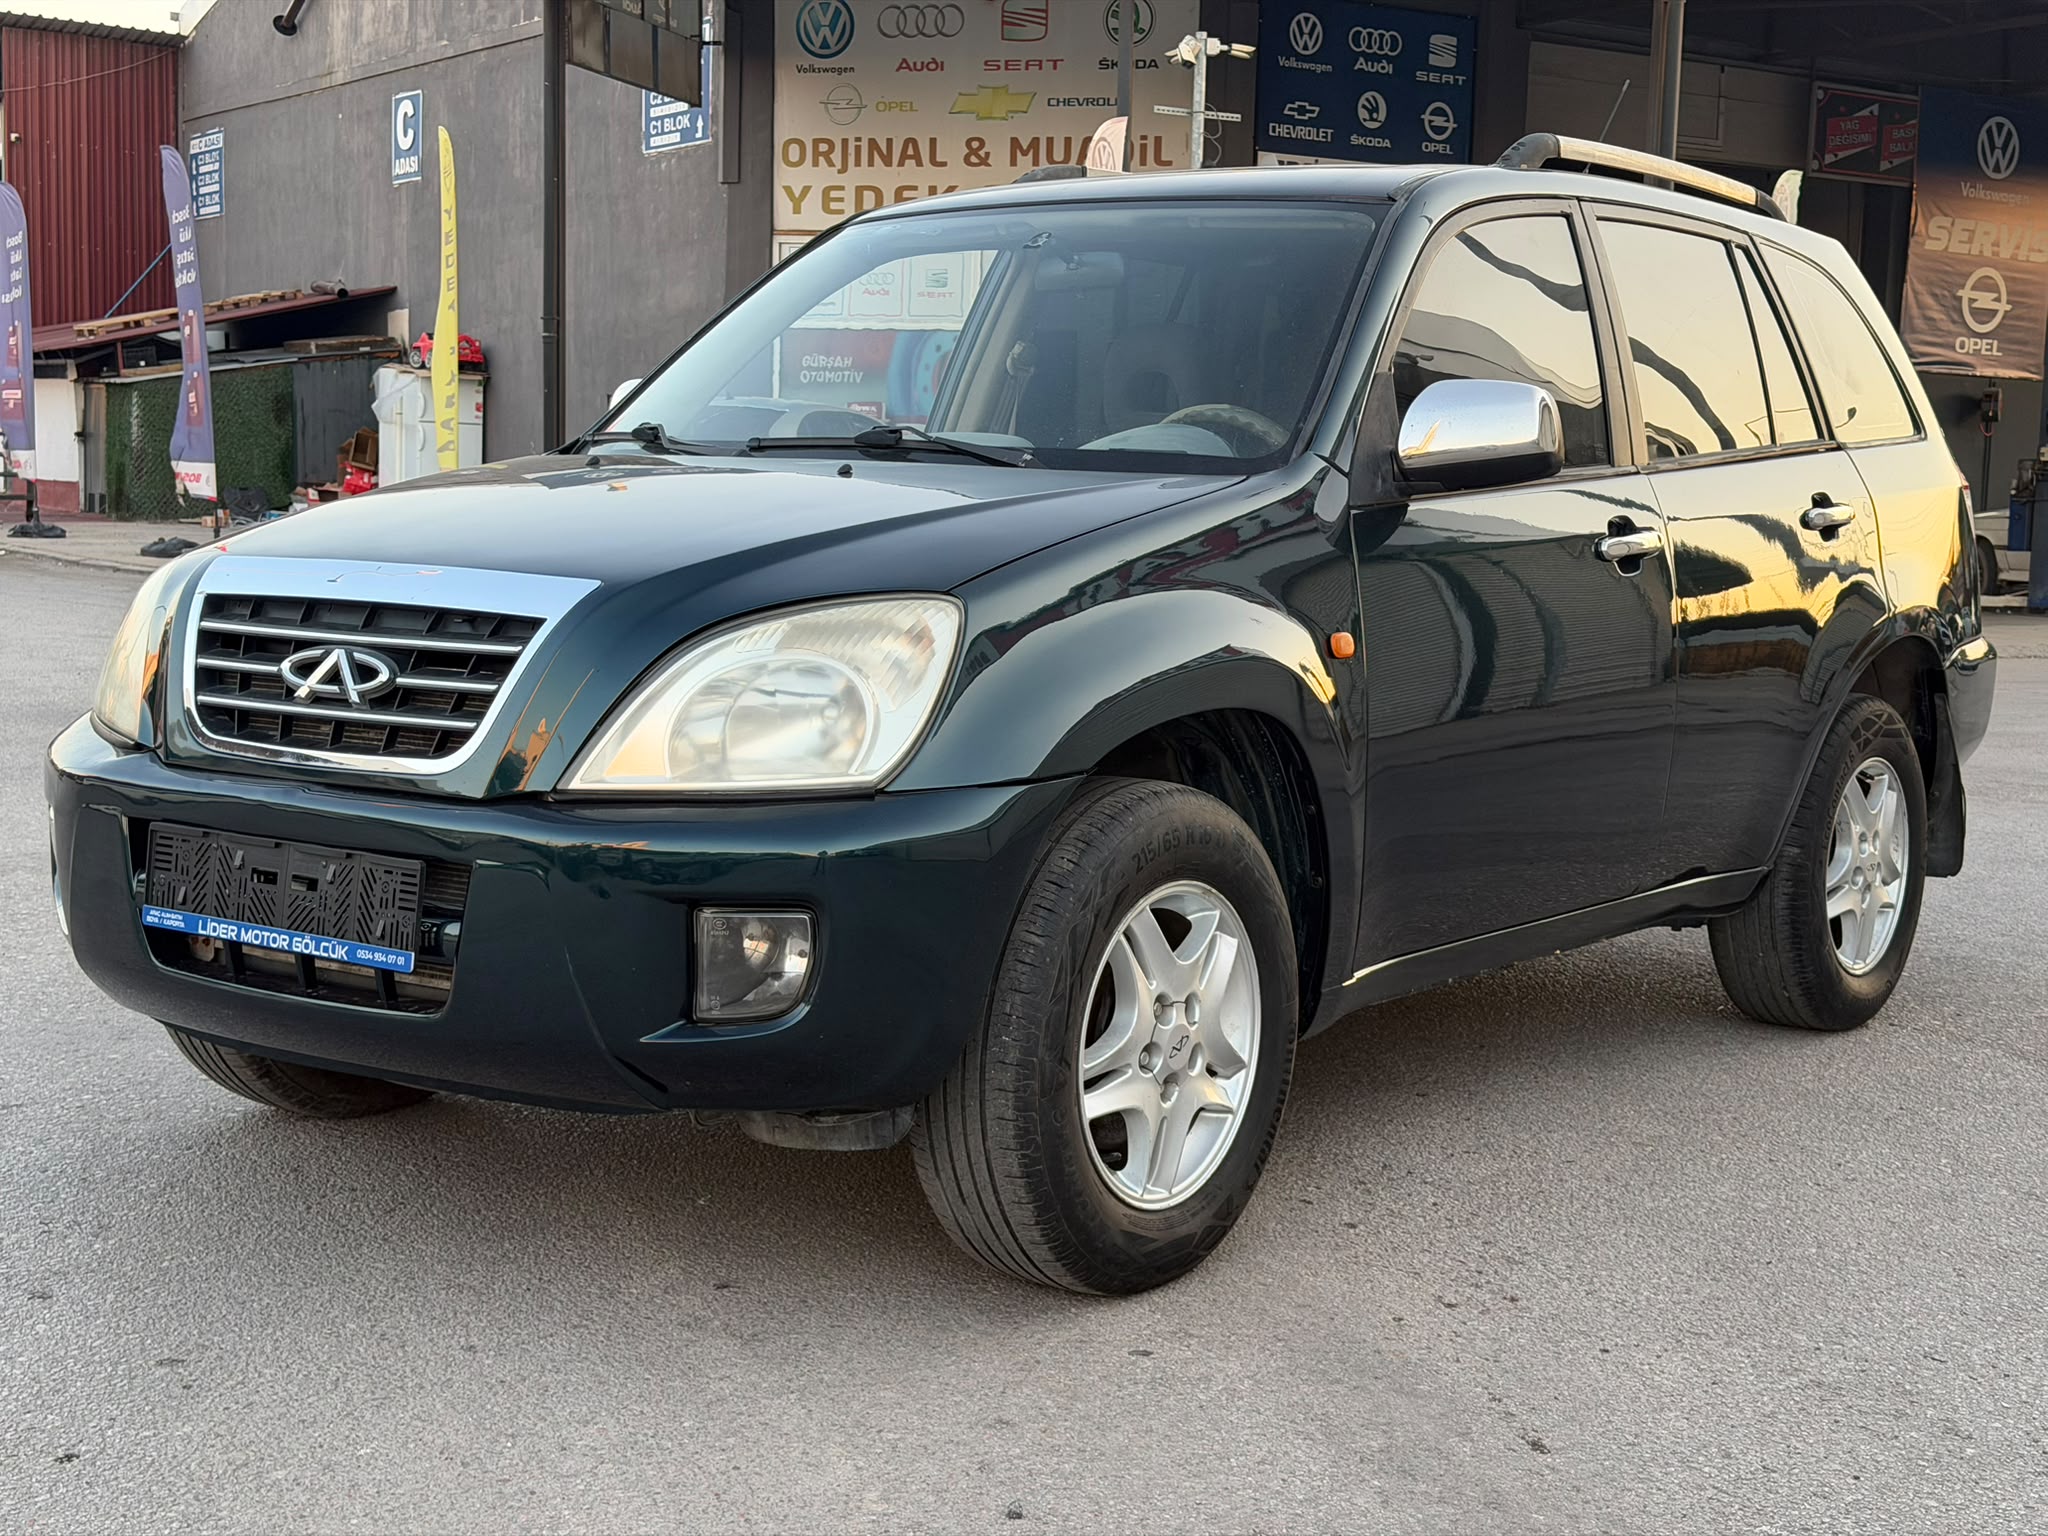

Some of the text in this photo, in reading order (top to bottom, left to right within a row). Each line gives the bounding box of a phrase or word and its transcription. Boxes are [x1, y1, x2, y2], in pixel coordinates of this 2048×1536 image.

[796, 64, 855, 76] Volkswagen
[895, 58, 945, 72] Audi
[983, 59, 1065, 71] SEAT
[1098, 57, 1160, 70] ŠKDA
[1278, 56, 1333, 73] Volkswagen
[1354, 57, 1393, 74] Audi
[1415, 71, 1467, 86] SEAT
[875, 100, 919, 113] OPEL
[397, 99, 415, 151] C
[650, 113, 691, 135] C1 BLOK
[1268, 123, 1334, 143] CHEVROLET
[1350, 133, 1392, 148] ŠKODA
[963, 137, 992, 167] &
[1421, 142, 1454, 155] OPEL
[395, 155, 418, 176] ADASI
[1960, 181, 2031, 207] Volkswagen
[1955, 336, 2003, 356] OPEL
[802, 354, 852, 369] GÜRŞAH
[800, 369, 863, 384] OTOMOTİV
[1132, 828, 1181, 875] 215/65
[198, 918, 238, 941] LİDER
[241, 927, 289, 951] MOTOR
[292, 935, 349, 960] GÖLCÜK
[356, 949, 373, 960] 0534
[374, 951, 386, 963] 934
[387, 954, 397, 964] 07
